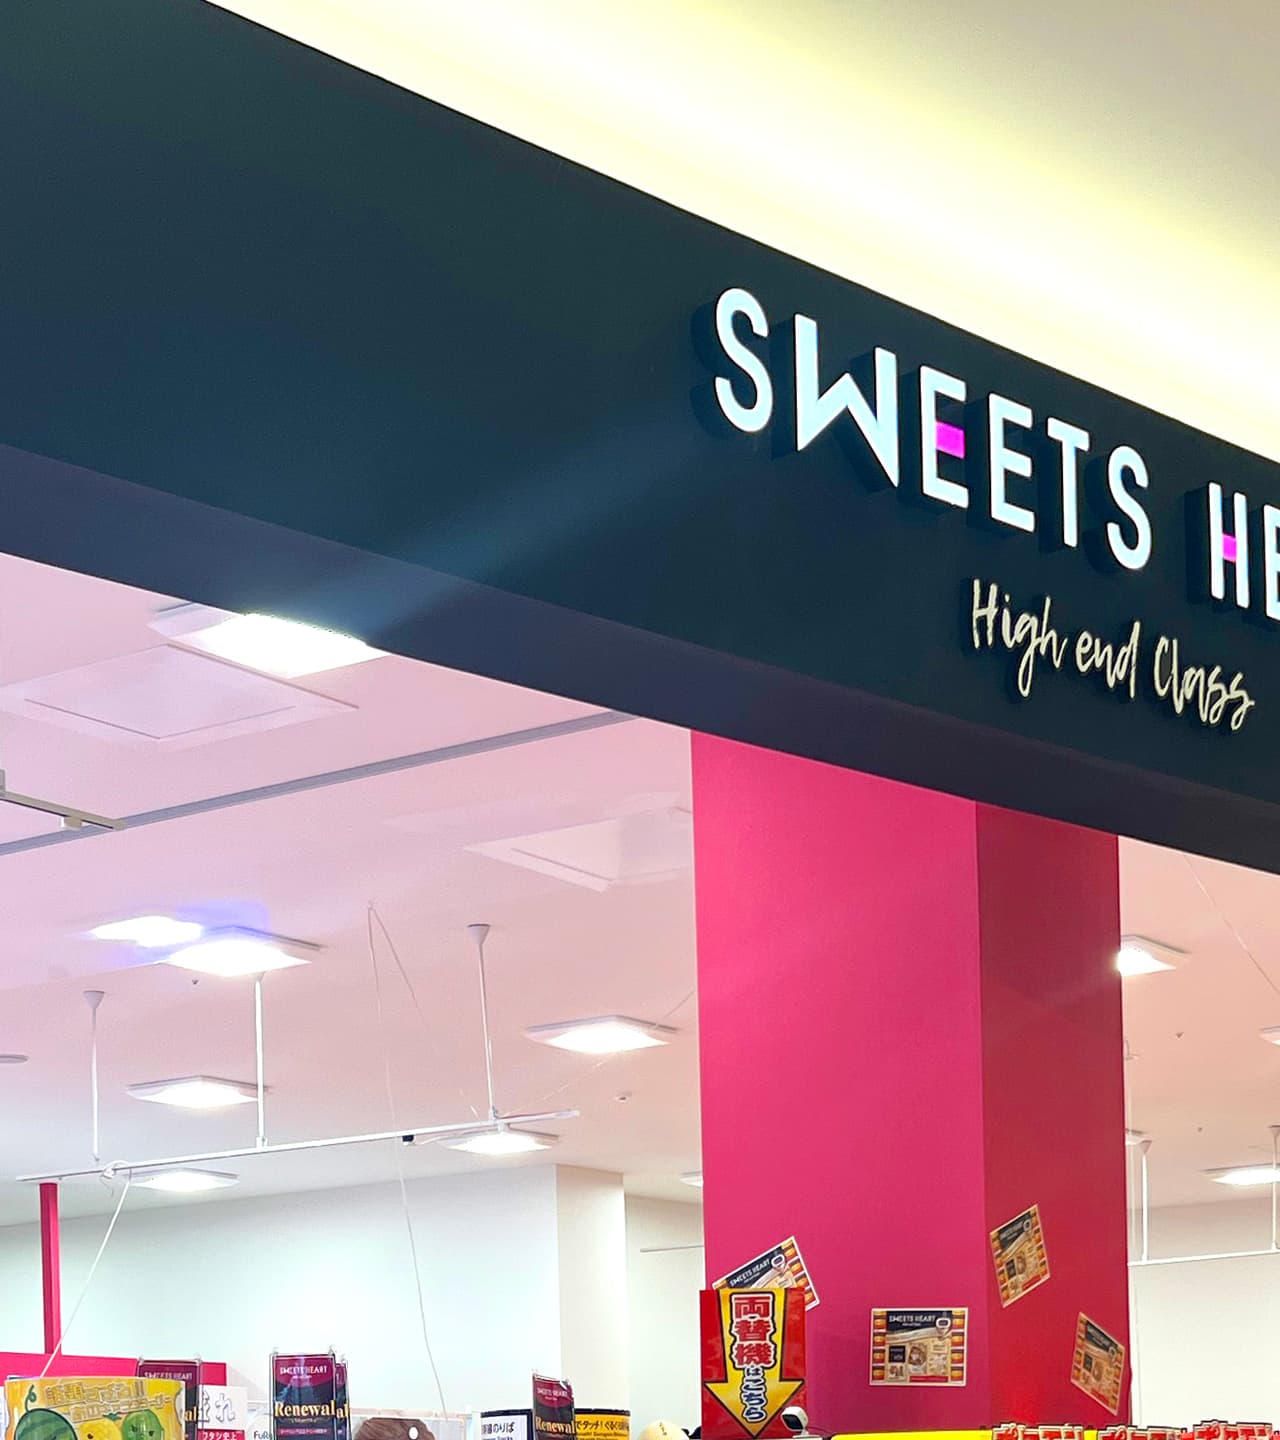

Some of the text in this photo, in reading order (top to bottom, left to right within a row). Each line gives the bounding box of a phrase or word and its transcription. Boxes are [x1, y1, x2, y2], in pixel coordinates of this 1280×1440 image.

[715, 288, 1152, 570] SWEETS
[971, 578, 1255, 731] High end Class
[274, 1400, 336, 1418] Renewal
[734, 1296, 773, 1420] 両替機はこちら
[535, 1415, 576, 1435] Renewal
